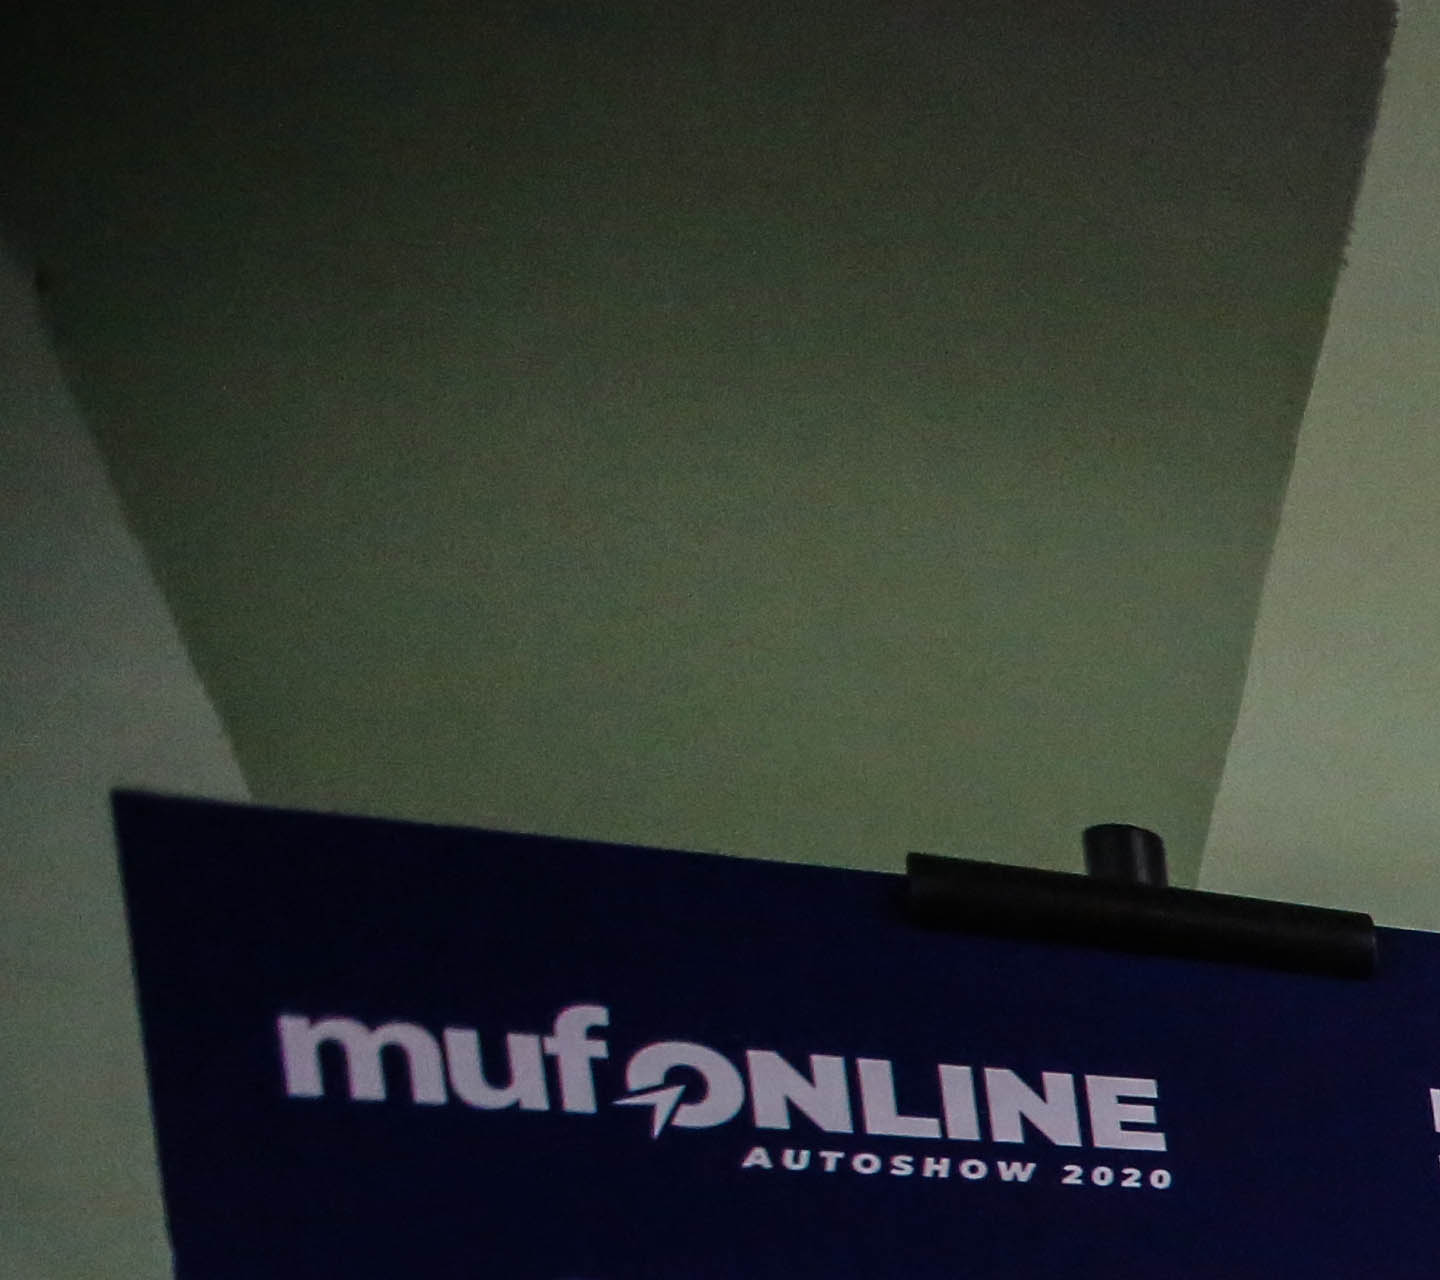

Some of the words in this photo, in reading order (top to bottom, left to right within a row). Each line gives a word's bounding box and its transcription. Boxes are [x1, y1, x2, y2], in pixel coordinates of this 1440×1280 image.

[276, 1004, 610, 1115] muf
[613, 1041, 1168, 1154] ONLINE
[741, 1146, 1036, 1182] AUTOSHOW
[1060, 1163, 1172, 1190] 2020
